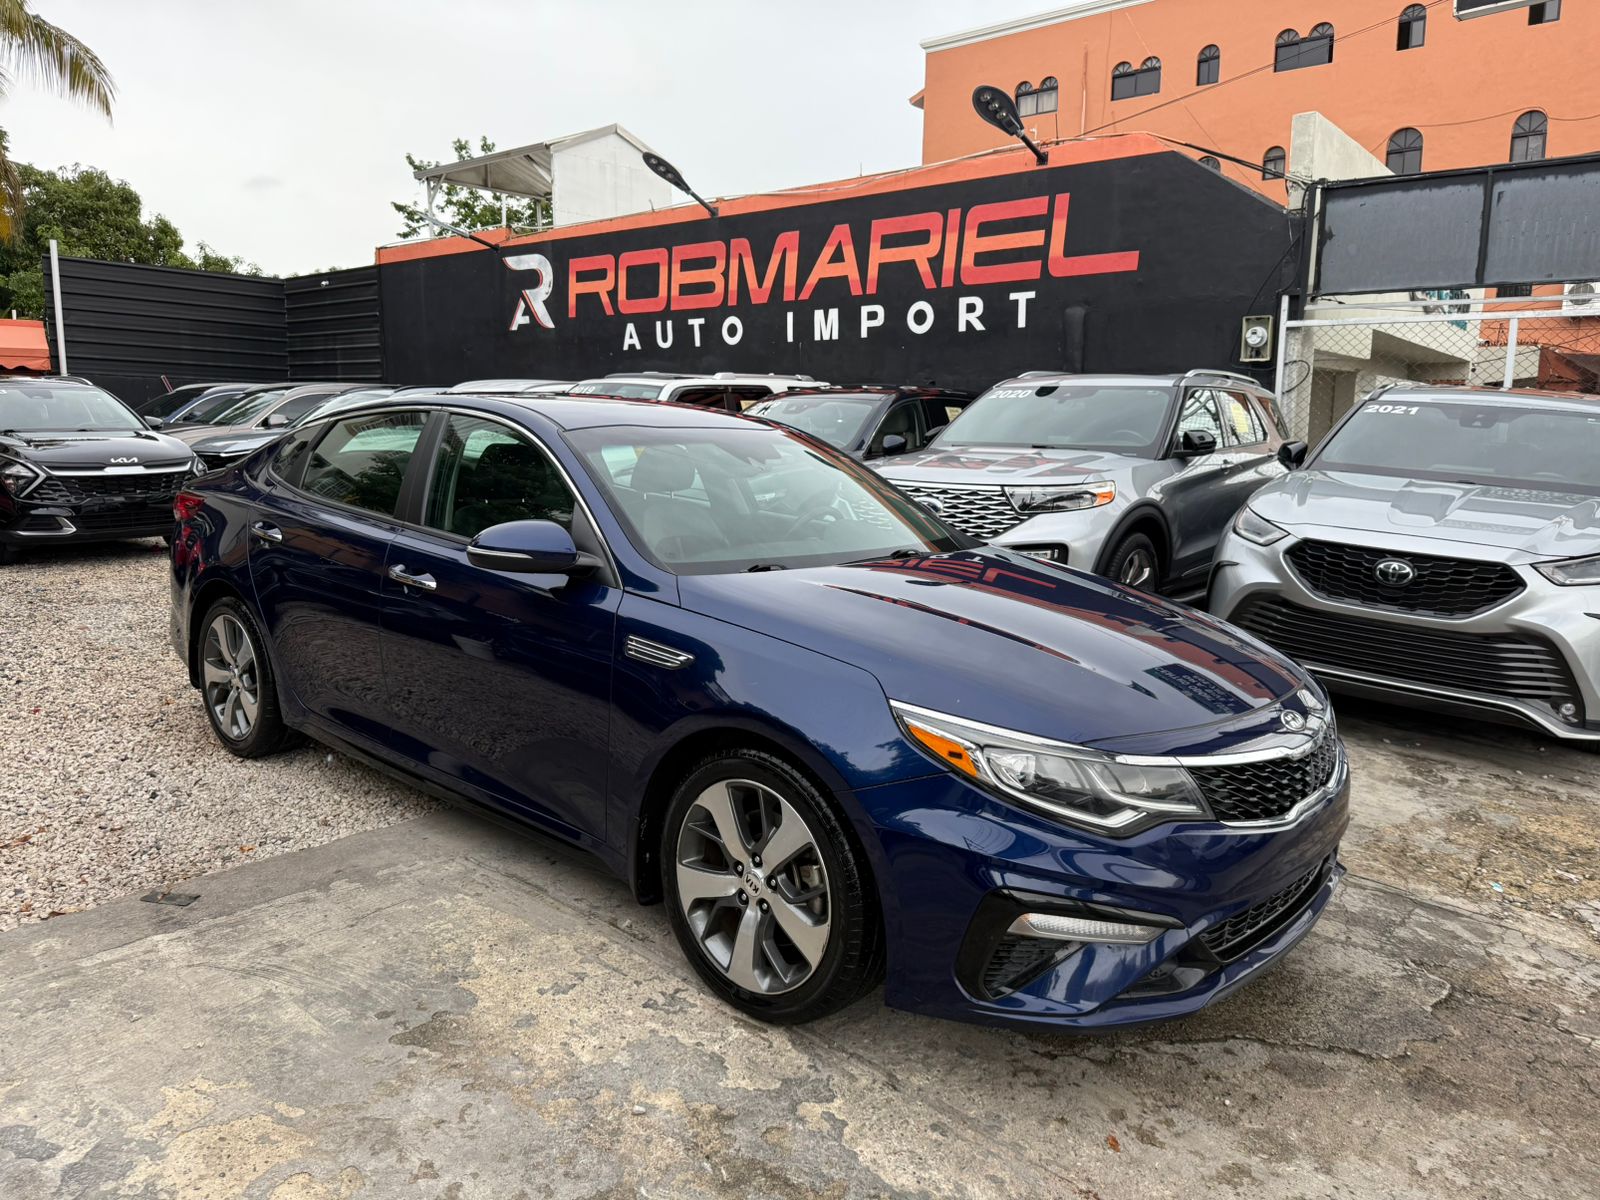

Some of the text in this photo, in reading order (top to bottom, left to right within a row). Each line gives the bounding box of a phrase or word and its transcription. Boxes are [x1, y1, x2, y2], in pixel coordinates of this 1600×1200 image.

[568, 192, 1140, 318] ROBMARIEL
[622, 290, 1036, 351] AUTO IMPORT
[989, 389, 1032, 399] 2020
[1363, 404, 1420, 415] 2021
[745, 874, 760, 894] KIA
